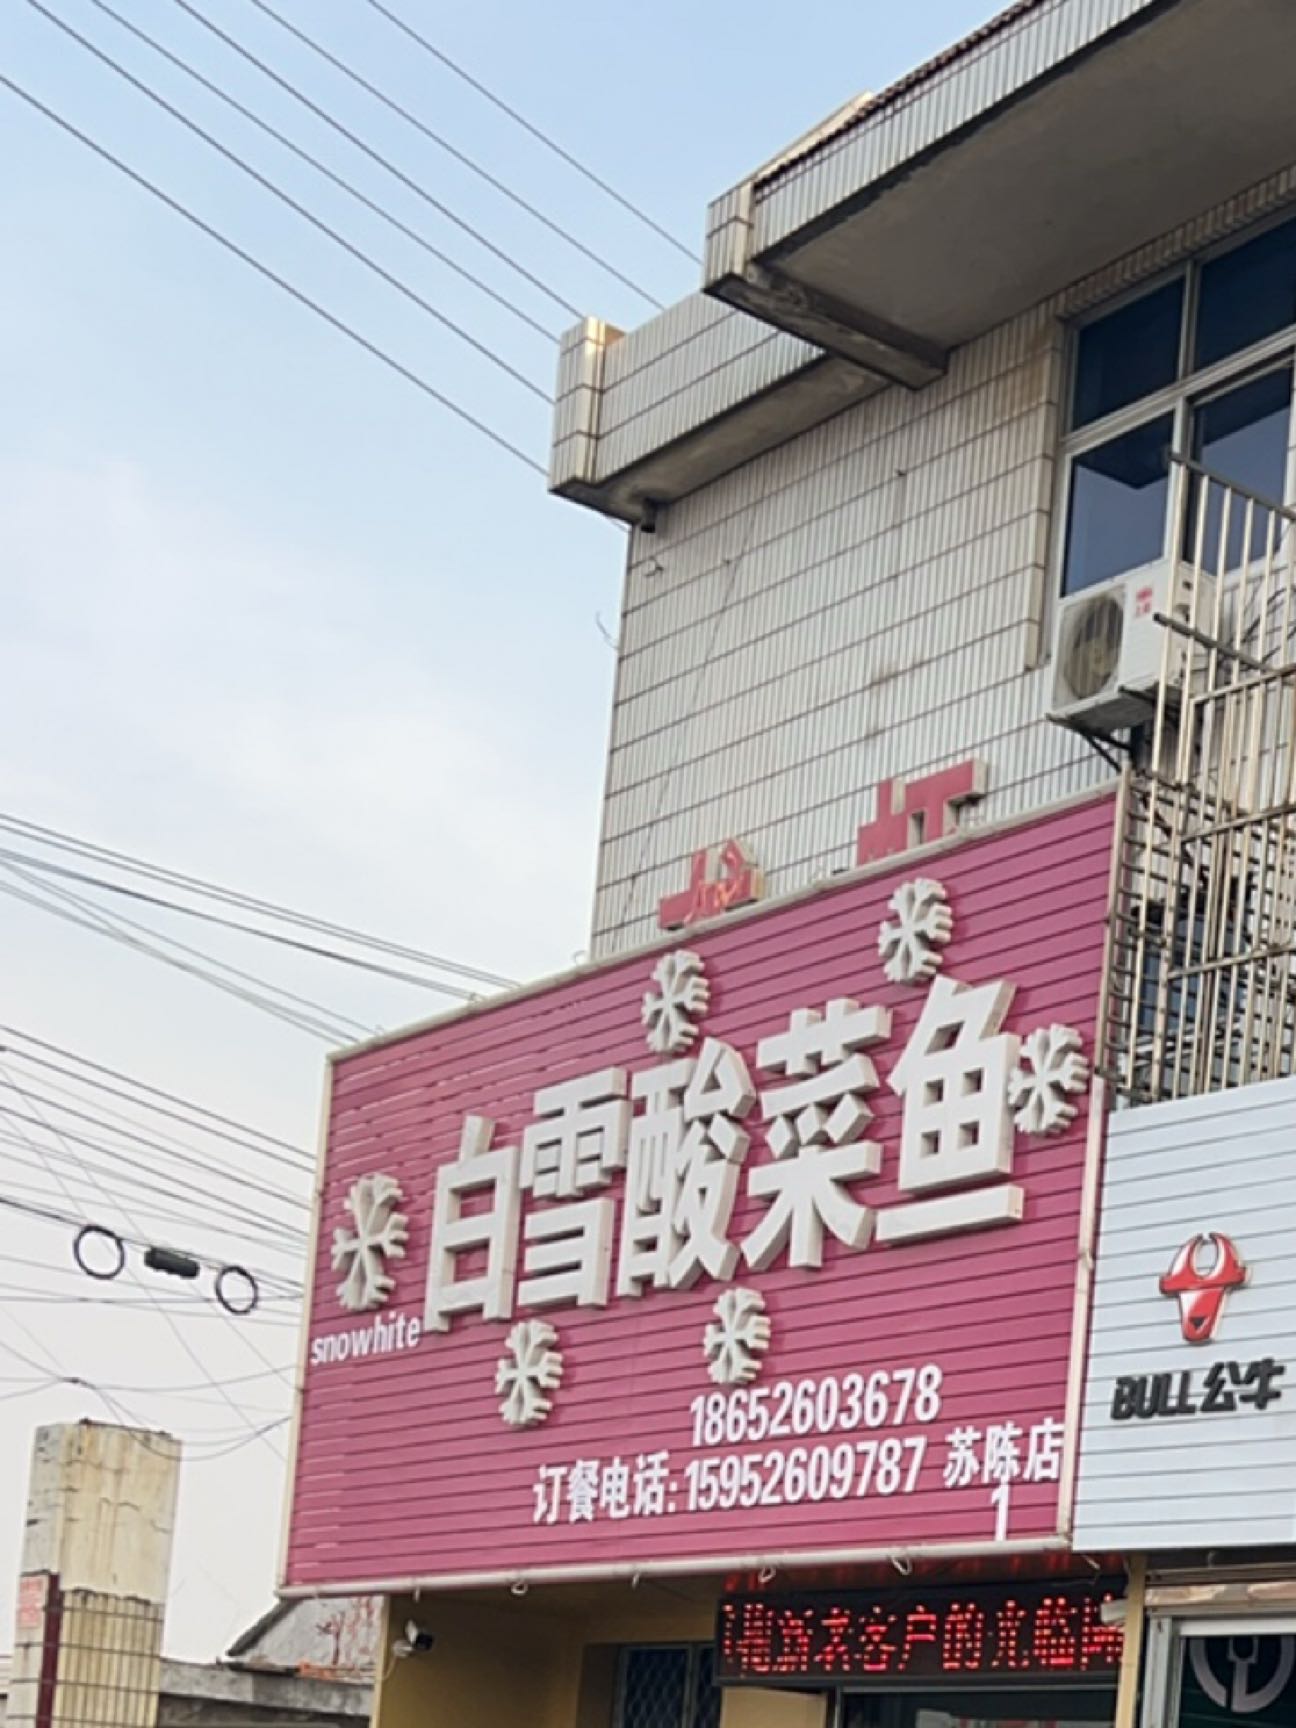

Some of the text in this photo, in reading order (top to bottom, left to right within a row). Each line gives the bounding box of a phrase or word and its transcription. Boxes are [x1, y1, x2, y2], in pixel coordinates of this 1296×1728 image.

[423, 976, 1024, 1332] 白雪酸菜鱼
[311, 1310, 420, 1366] snowhite
[690, 1364, 942, 1447] 18652603678
[943, 1417, 1064, 1488] 苏陈店
